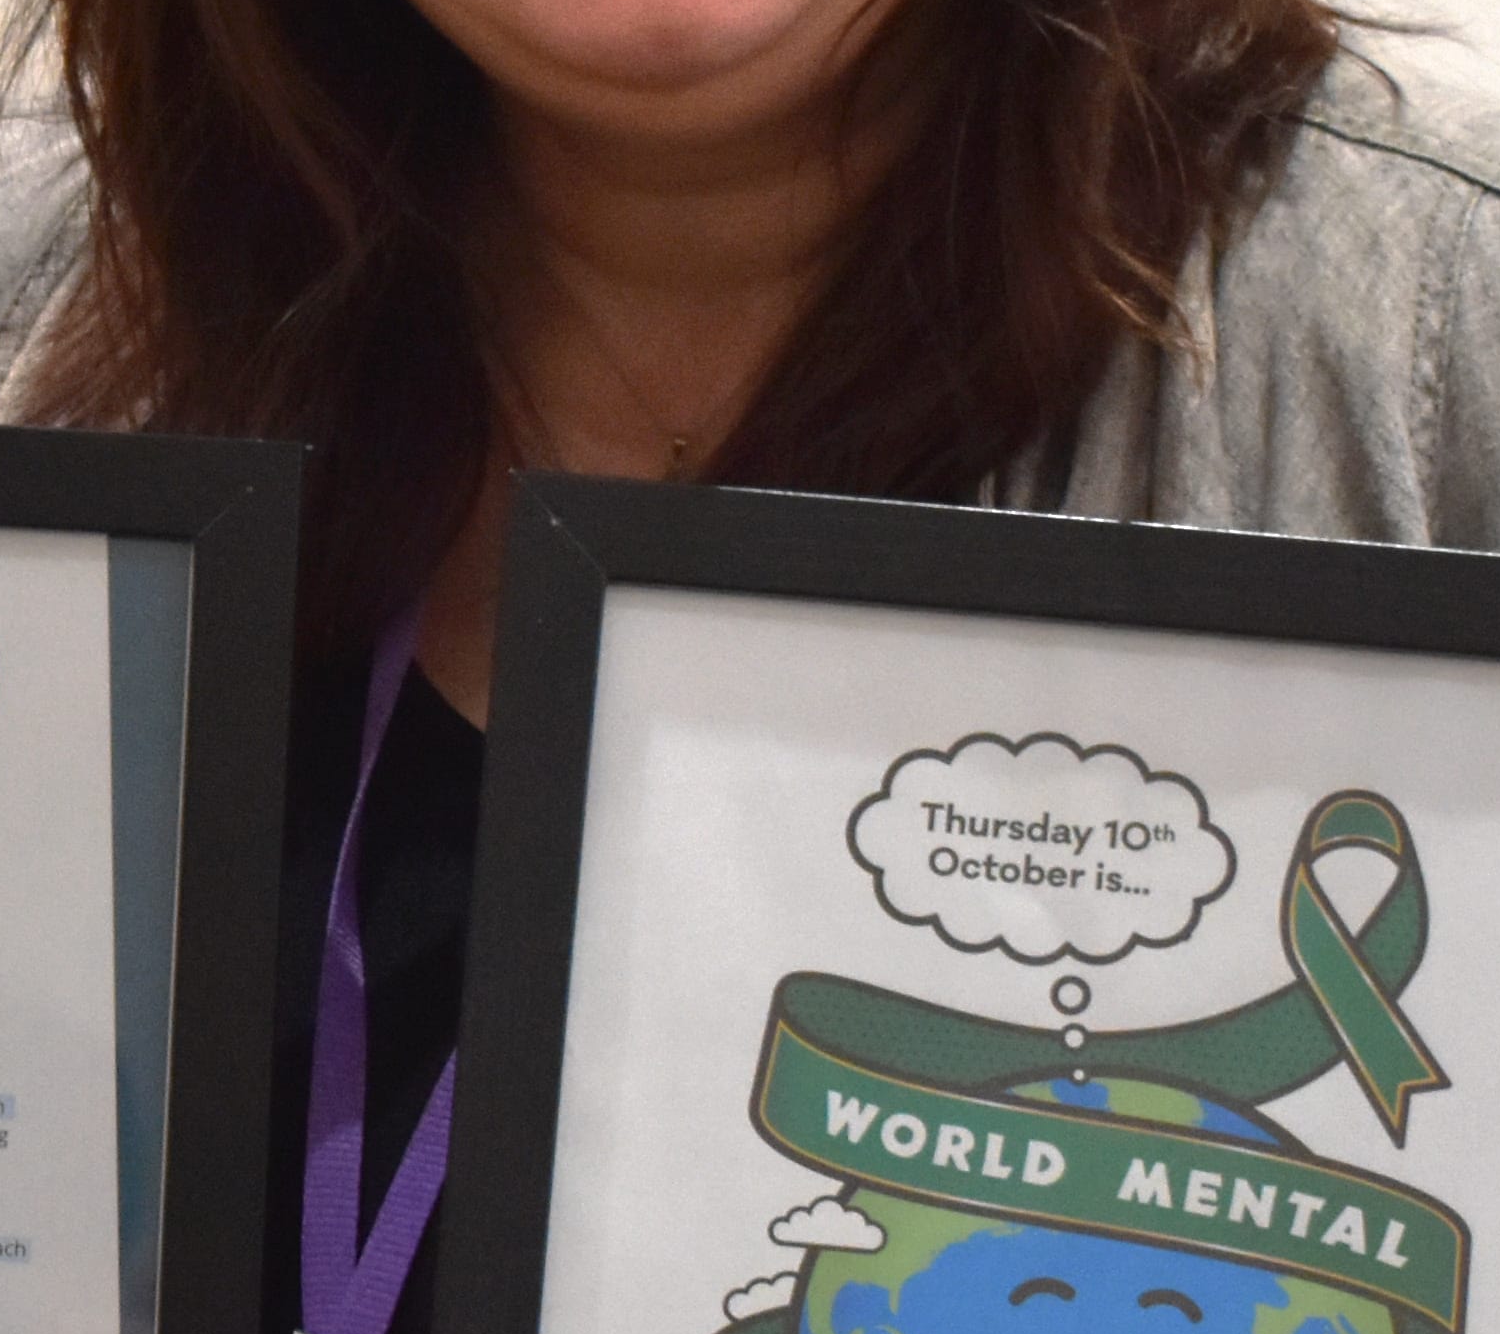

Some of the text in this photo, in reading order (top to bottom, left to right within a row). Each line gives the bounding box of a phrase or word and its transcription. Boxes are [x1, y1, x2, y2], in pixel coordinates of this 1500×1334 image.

[922, 801, 1177, 853] Thursday 10th
[928, 847, 1151, 896] October is...
[825, 1090, 1411, 1269] WORLD MENTAL
